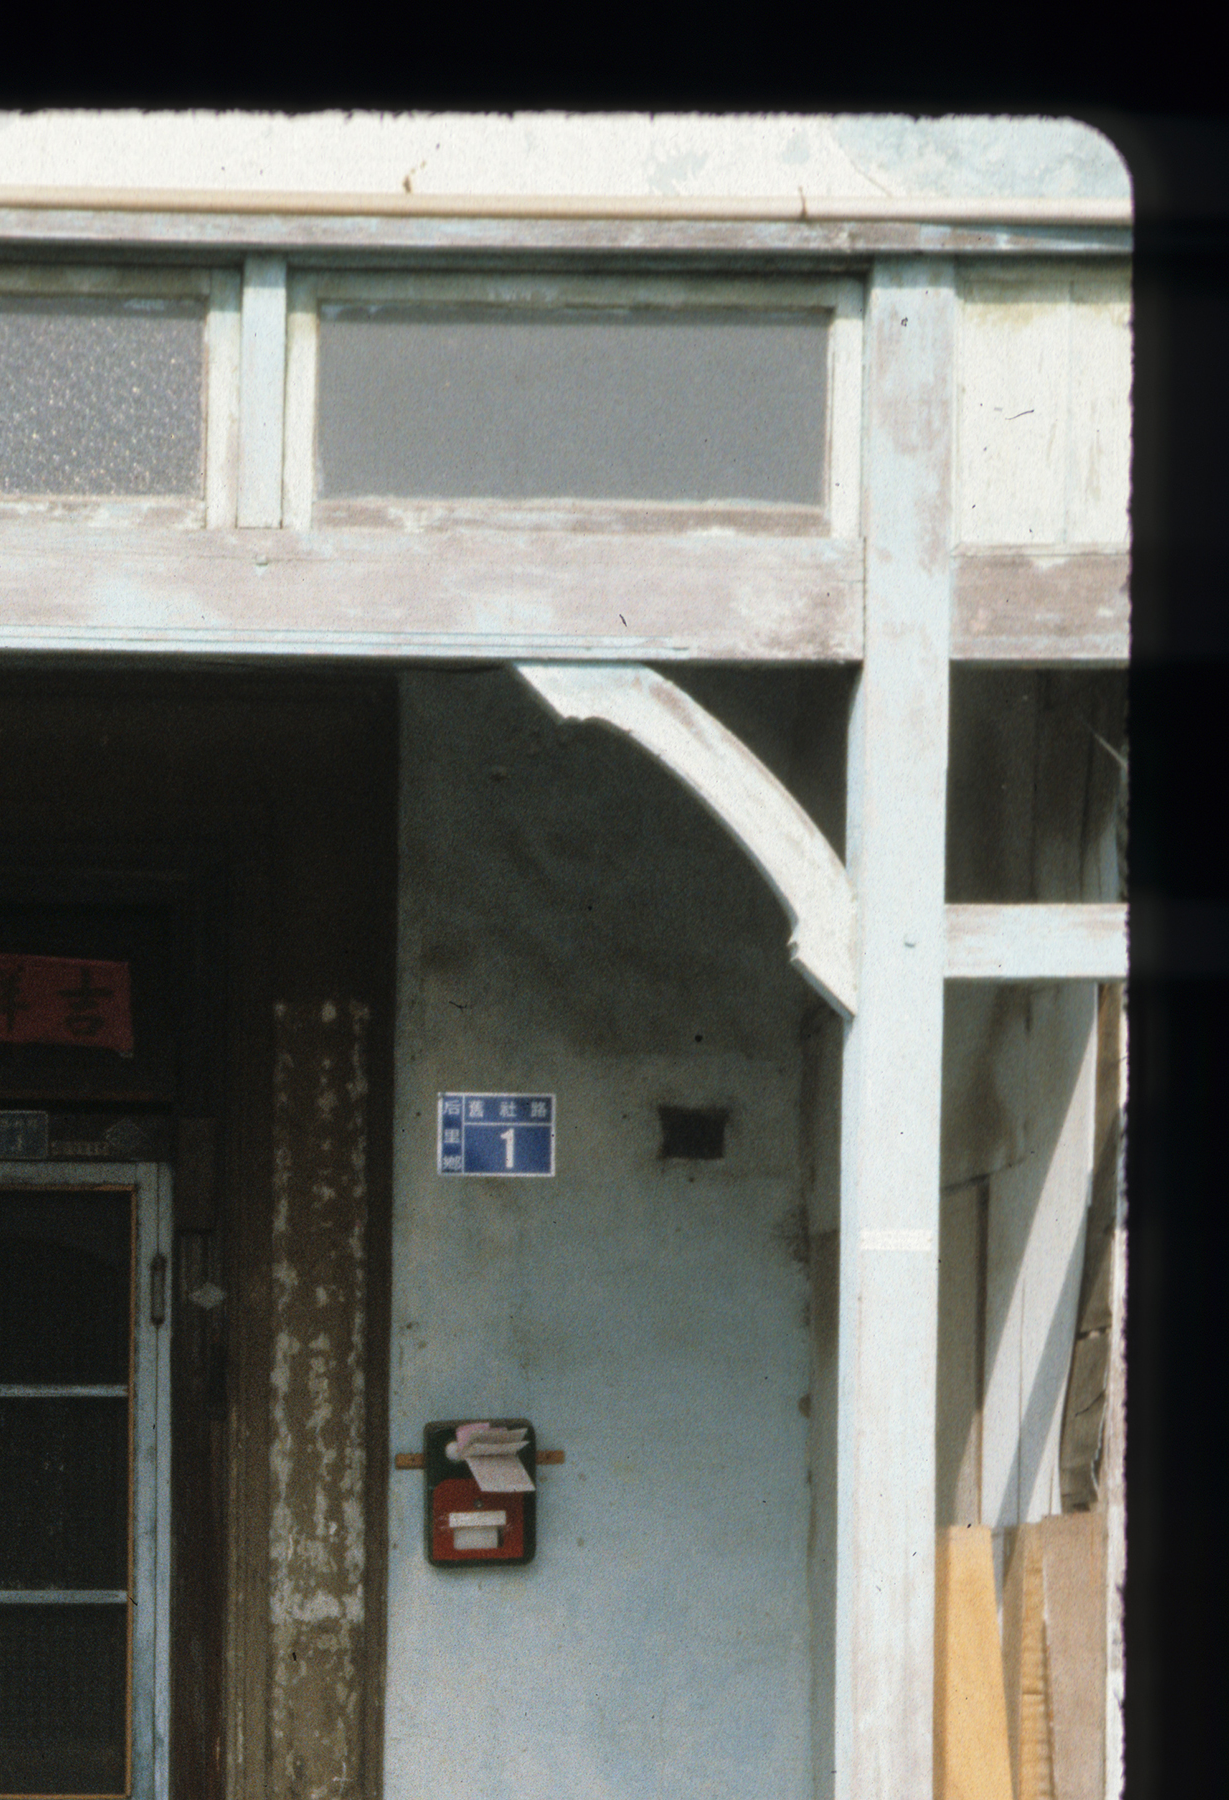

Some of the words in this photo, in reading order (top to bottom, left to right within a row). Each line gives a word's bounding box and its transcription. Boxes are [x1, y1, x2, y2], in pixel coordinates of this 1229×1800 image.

[468, 1099, 547, 1118] 舊社路
[443, 1099, 462, 1171] 后里鄉
[500, 1128, 515, 1169] 1
